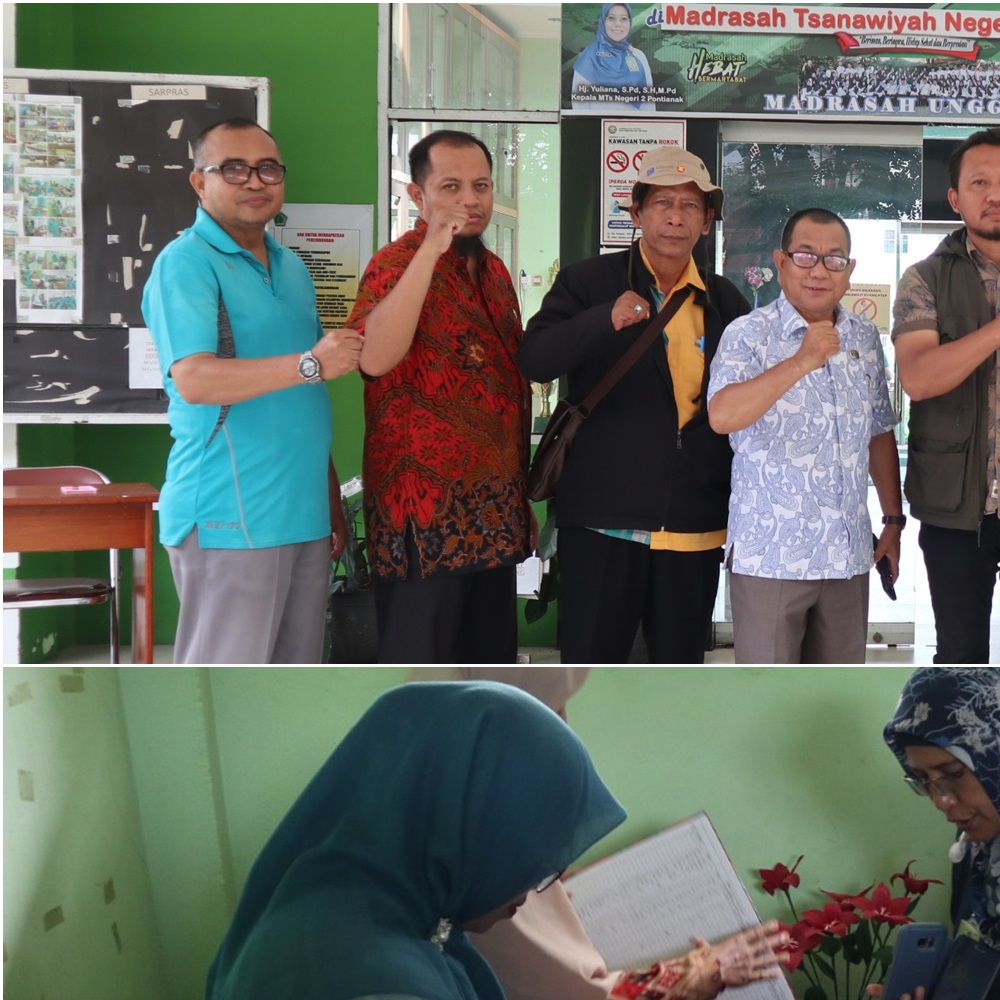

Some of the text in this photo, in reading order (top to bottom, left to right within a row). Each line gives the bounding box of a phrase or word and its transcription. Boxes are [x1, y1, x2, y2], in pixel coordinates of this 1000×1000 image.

[647, 8, 664, 26] di
[666, 6, 786, 27] Madrasah
[793, 8, 936, 34] Tsanawiyah
[705, 52, 748, 61] Madrasah
[697, 75, 748, 83] BERMARTABAT
[148, 88, 189, 97] SARPRAS
[591, 86, 620, 94] Yuliana,
[571, 94, 597, 102] Kepala
[615, 95, 640, 103] Negeri
[647, 95, 684, 103] Pontianak
[763, 94, 917, 113] MADRASAH
